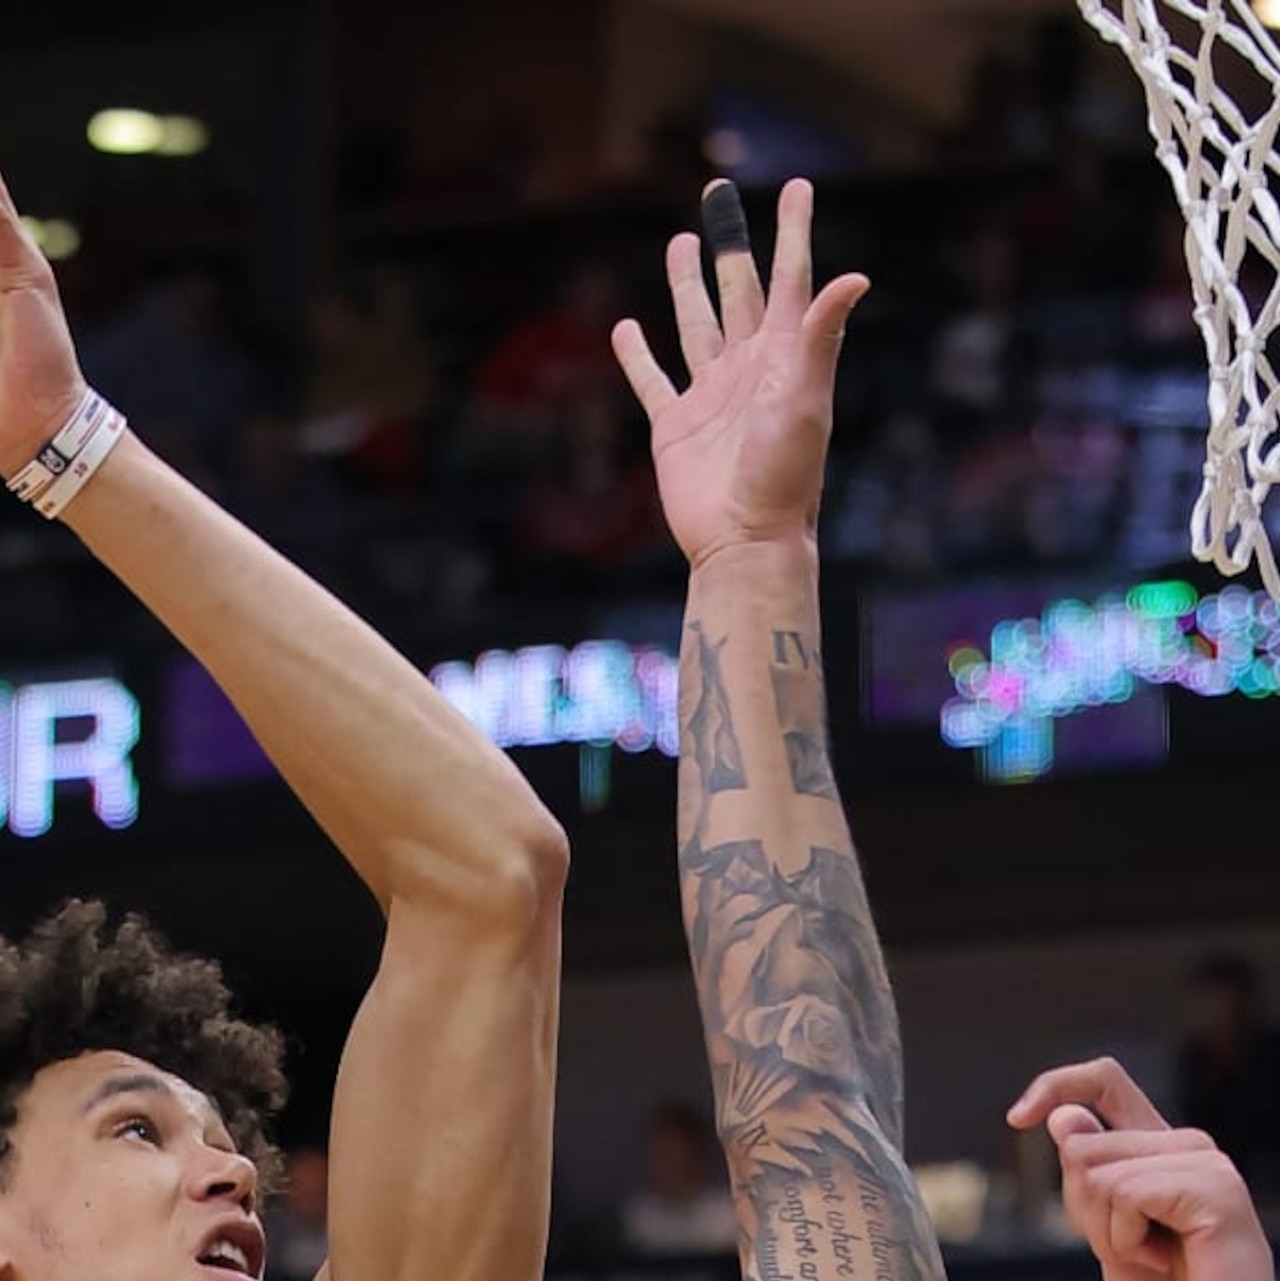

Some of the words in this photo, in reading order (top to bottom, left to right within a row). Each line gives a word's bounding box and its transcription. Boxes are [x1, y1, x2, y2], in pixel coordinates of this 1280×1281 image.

[818, 1166, 846, 1203] not
[778, 1183, 823, 1258] omfort
[826, 1211, 863, 1277] where
